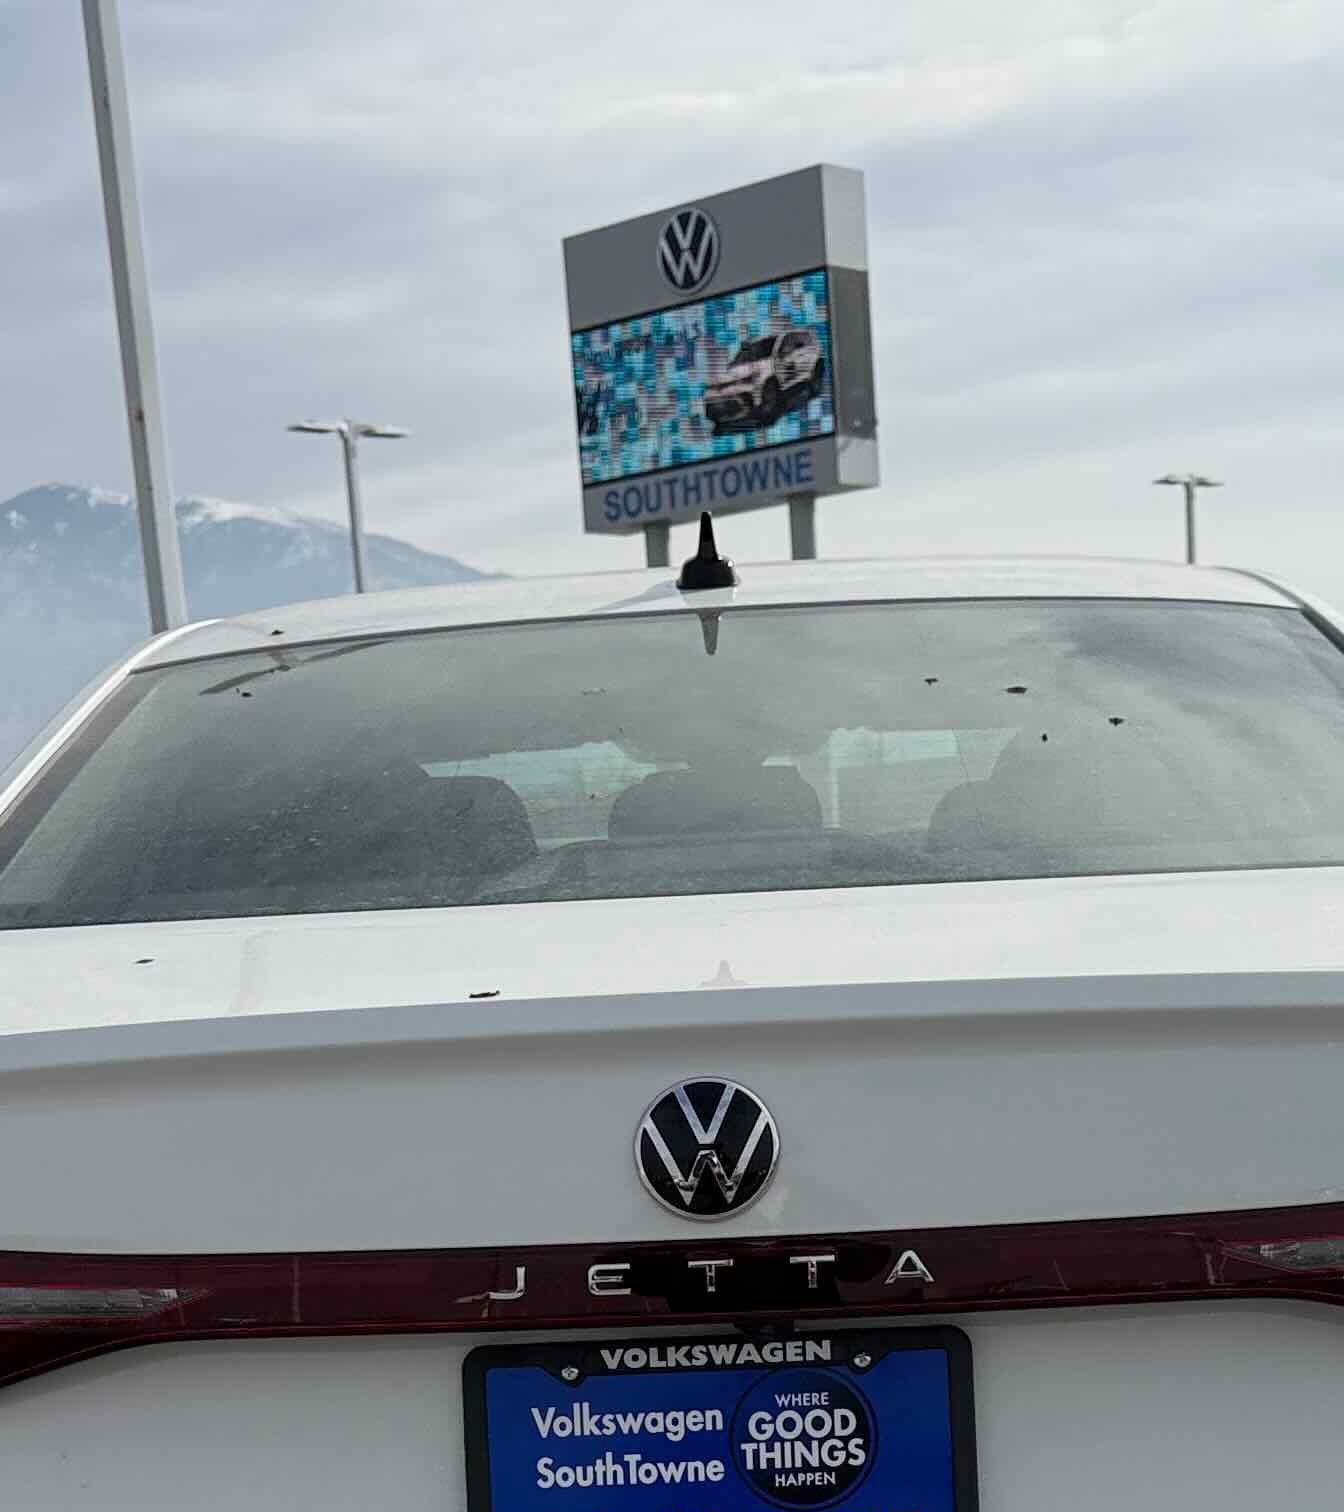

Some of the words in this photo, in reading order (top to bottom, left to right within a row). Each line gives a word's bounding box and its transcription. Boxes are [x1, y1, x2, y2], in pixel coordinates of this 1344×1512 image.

[605, 450, 813, 521] SOUTHTOWNE
[488, 1250, 935, 1300] JETTA
[600, 1340, 831, 1370] VOLKSWAGEN
[774, 1392, 829, 1407] WHERE
[531, 1403, 723, 1441] Volkswagen
[747, 1408, 856, 1440] GOOD
[537, 1452, 725, 1489] SouthTowne
[741, 1438, 866, 1471] THINGS
[775, 1472, 836, 1487] HAPPEN
